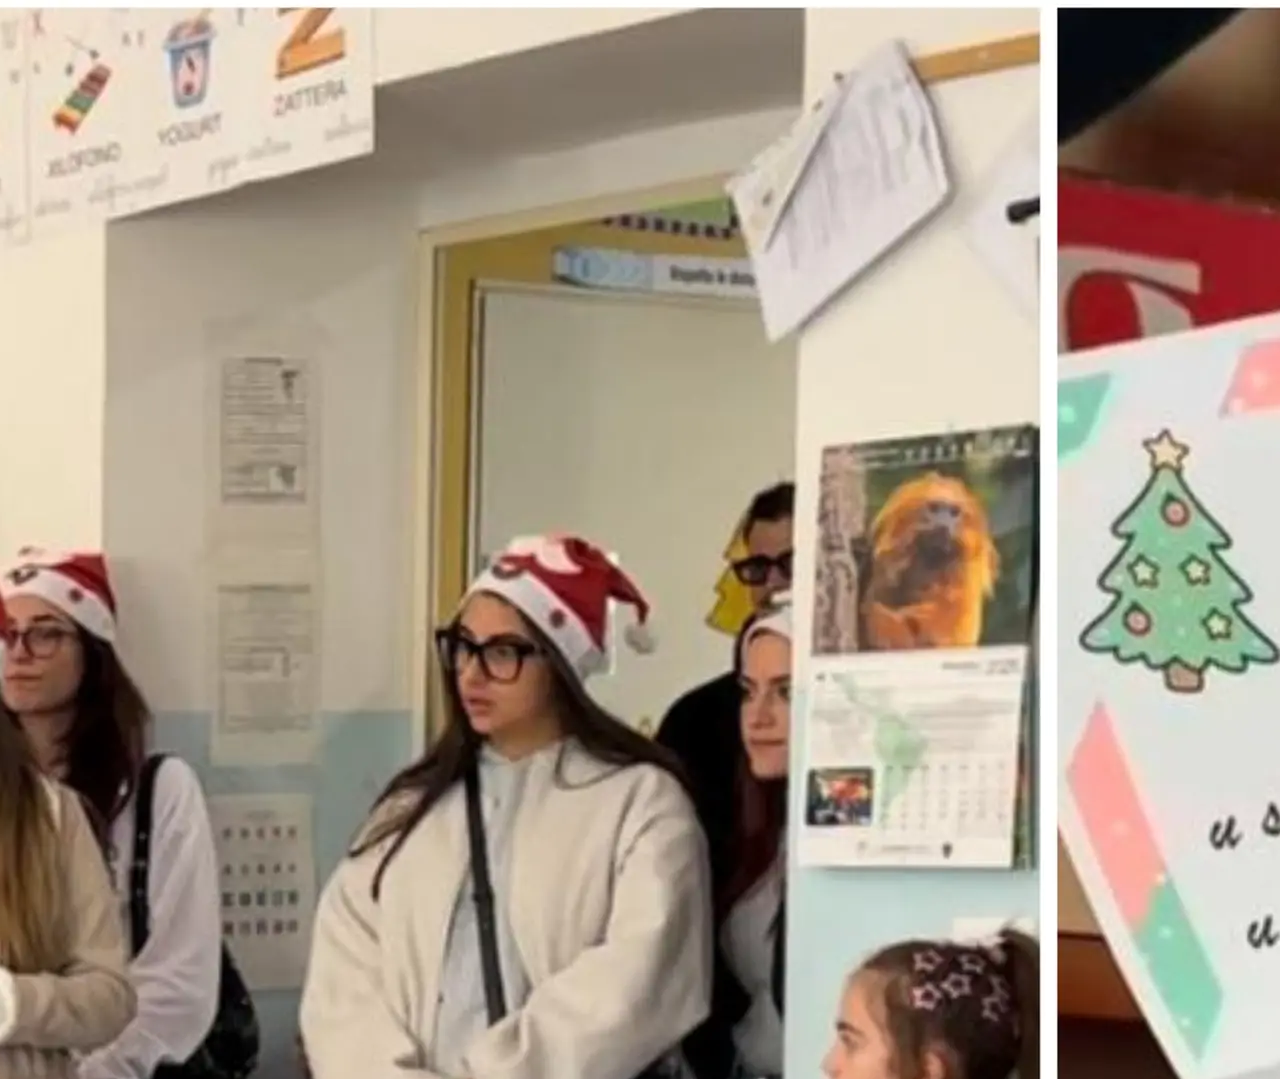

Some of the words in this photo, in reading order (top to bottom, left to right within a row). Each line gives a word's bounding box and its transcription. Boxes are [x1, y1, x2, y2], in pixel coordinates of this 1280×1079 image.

[272, 79, 349, 118] ZATTERA
[1209, 813, 1241, 850] u
[1246, 916, 1280, 949] u
